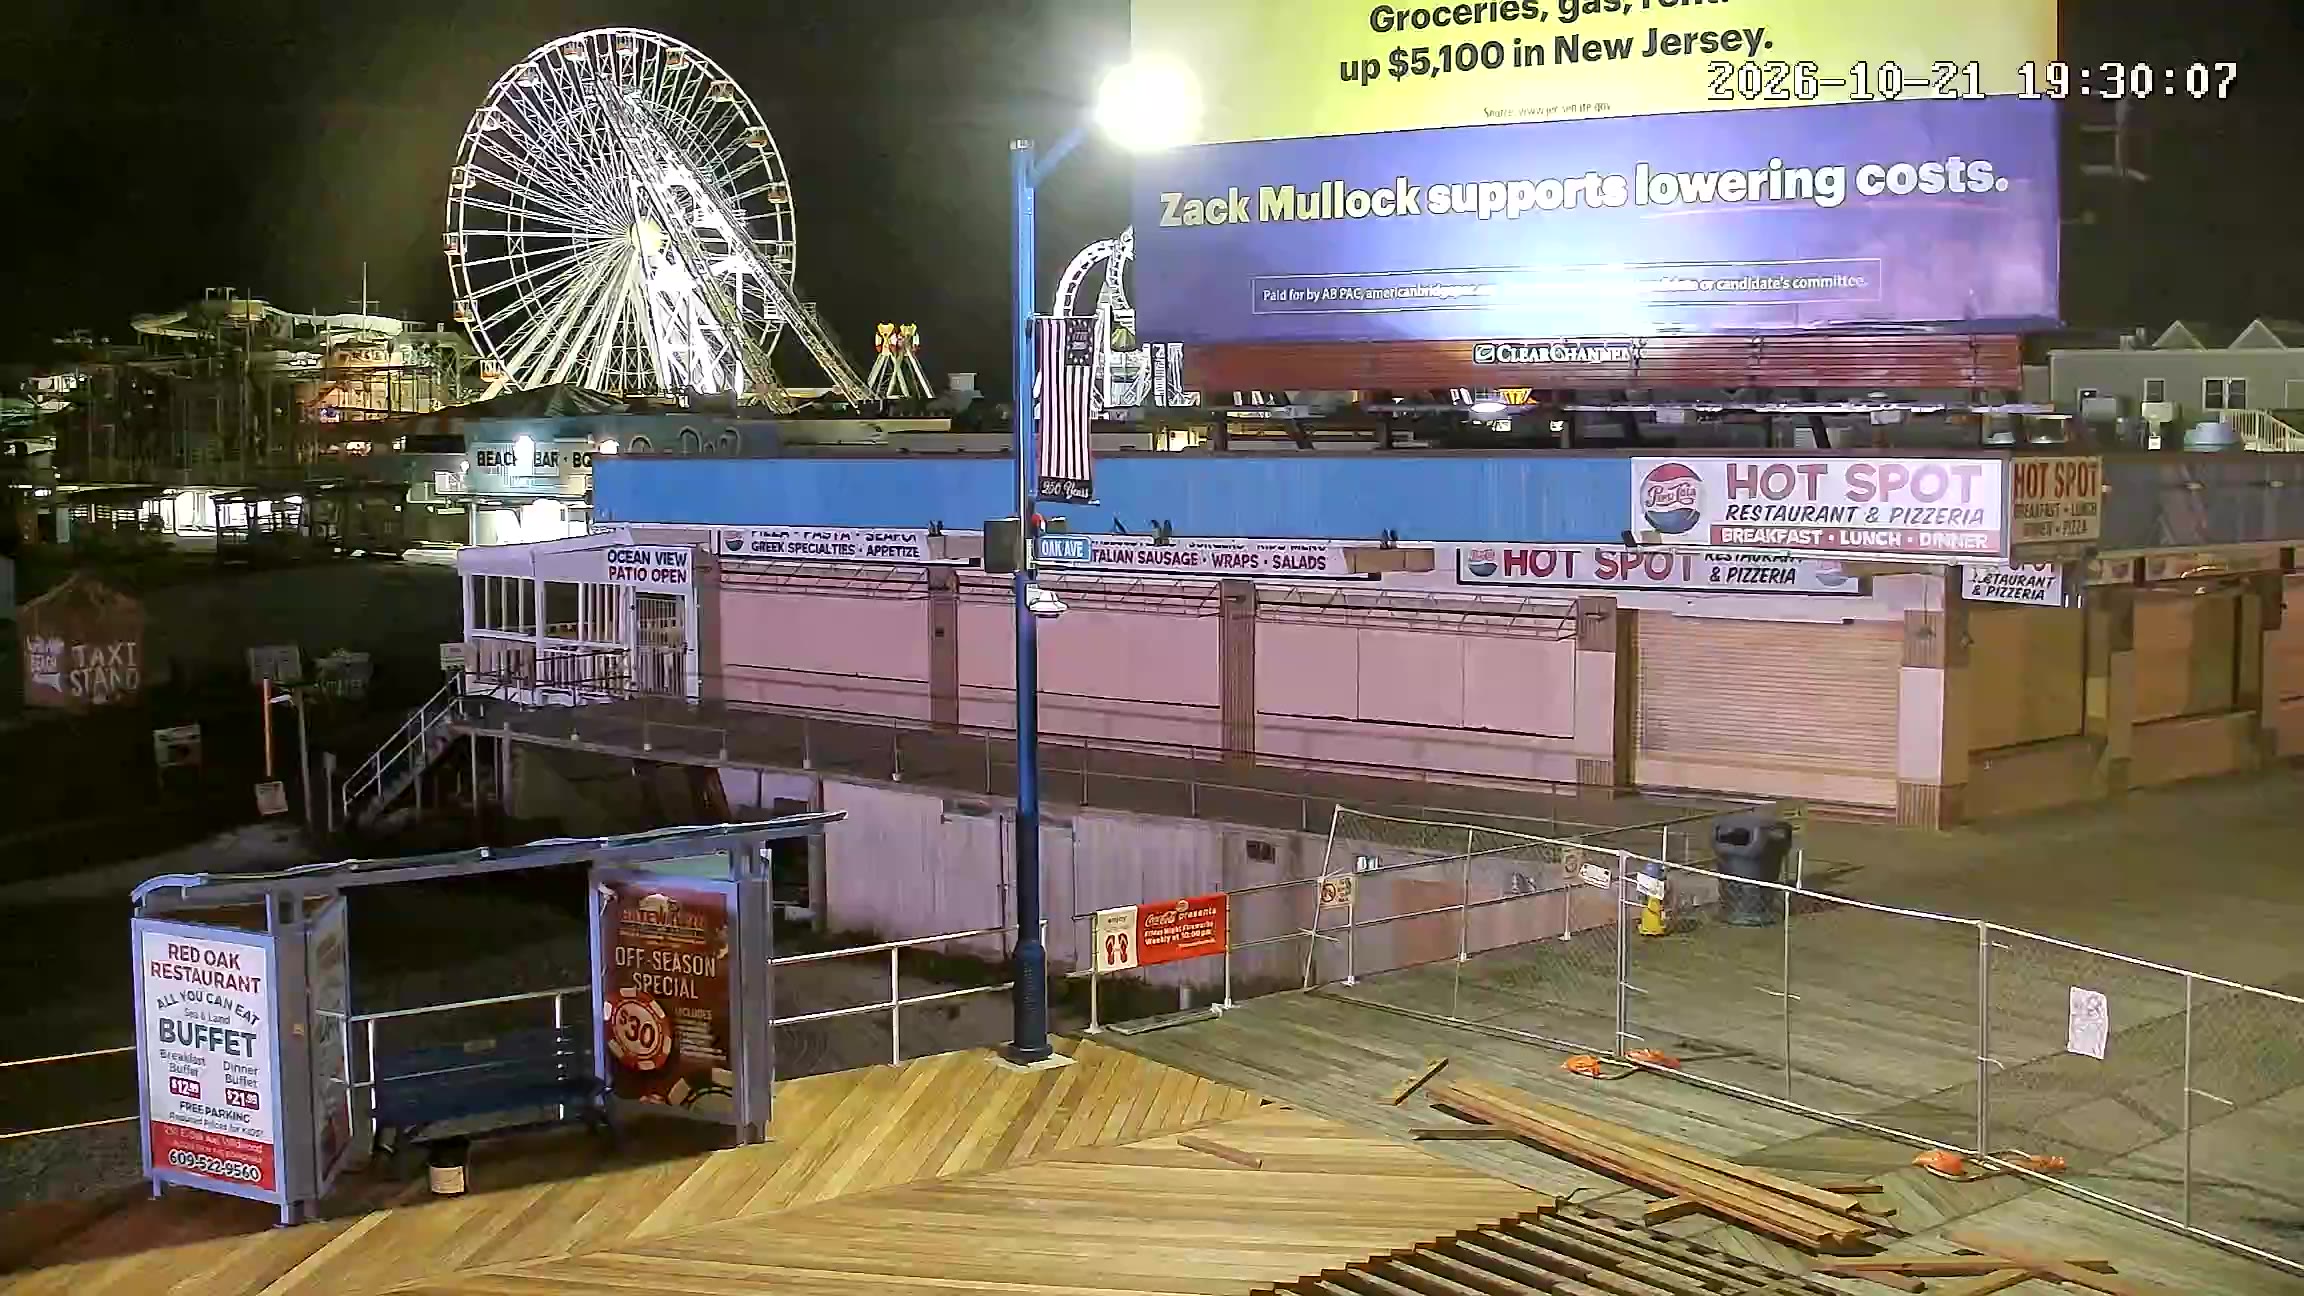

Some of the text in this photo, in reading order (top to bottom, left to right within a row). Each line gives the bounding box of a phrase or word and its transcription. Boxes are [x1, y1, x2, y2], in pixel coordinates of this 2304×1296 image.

[1370, 0, 1549, 32] Groceries,
[1341, 27, 1773, 86] up $5,100 in New Jersey.
[1160, 155, 2009, 226] Zack Mullock supports lowering costs.
[1263, 289, 1286, 301] Paid
[1288, 288, 1305, 301] for
[1306, 287, 1320, 302] by
[1322, 287, 1337, 300] AB
[1716, 276, 1790, 291] candidate's
[1792, 272, 1868, 289] committee.
[1041, 480, 1089, 499] 250 Years
[1727, 463, 1983, 504] HOT SPOT
[2014, 461, 2098, 500] HOT SPOT
[1725, 504, 1985, 525] RESTAURANT & PIZZERIA
[2014, 503, 2060, 519] EAKFAST
[751, 541, 921, 558] GREEK SPECIALTIES APPETIZE
[1041, 540, 1083, 557] OAK AVE
[1721, 527, 1989, 549] BREAKFAST LUNCH DINNER
[607, 549, 687, 566] OCEAN VIEW
[1092, 549, 1327, 571] TALIAN SAUSAGE WRAPS SALADS
[1503, 549, 1582, 578] HOT
[1594, 548, 1690, 582] SPOT
[609, 566, 687, 583] PATIO OPEN
[1709, 566, 1797, 585] & PIZZERIA
[1972, 585, 2046, 600] & PIZZERIA
[71, 641, 137, 668] TAXI
[69, 667, 140, 697] STAND
[167, 943, 241, 971] RED OAK
[150, 960, 261, 994] RESTAURANT
[632, 972, 699, 1000] SPECIAL
[157, 990, 260, 1026] ALL YOU CAN EAT
[159, 1018, 256, 1058] BUFFET
[619, 1008, 656, 1049] $30
[169, 1062, 199, 1077] Buffet
[223, 1060, 259, 1076] Dinner
[225, 1074, 259, 1089] Buffet
[180, 1101, 251, 1124] FREE PARKING
